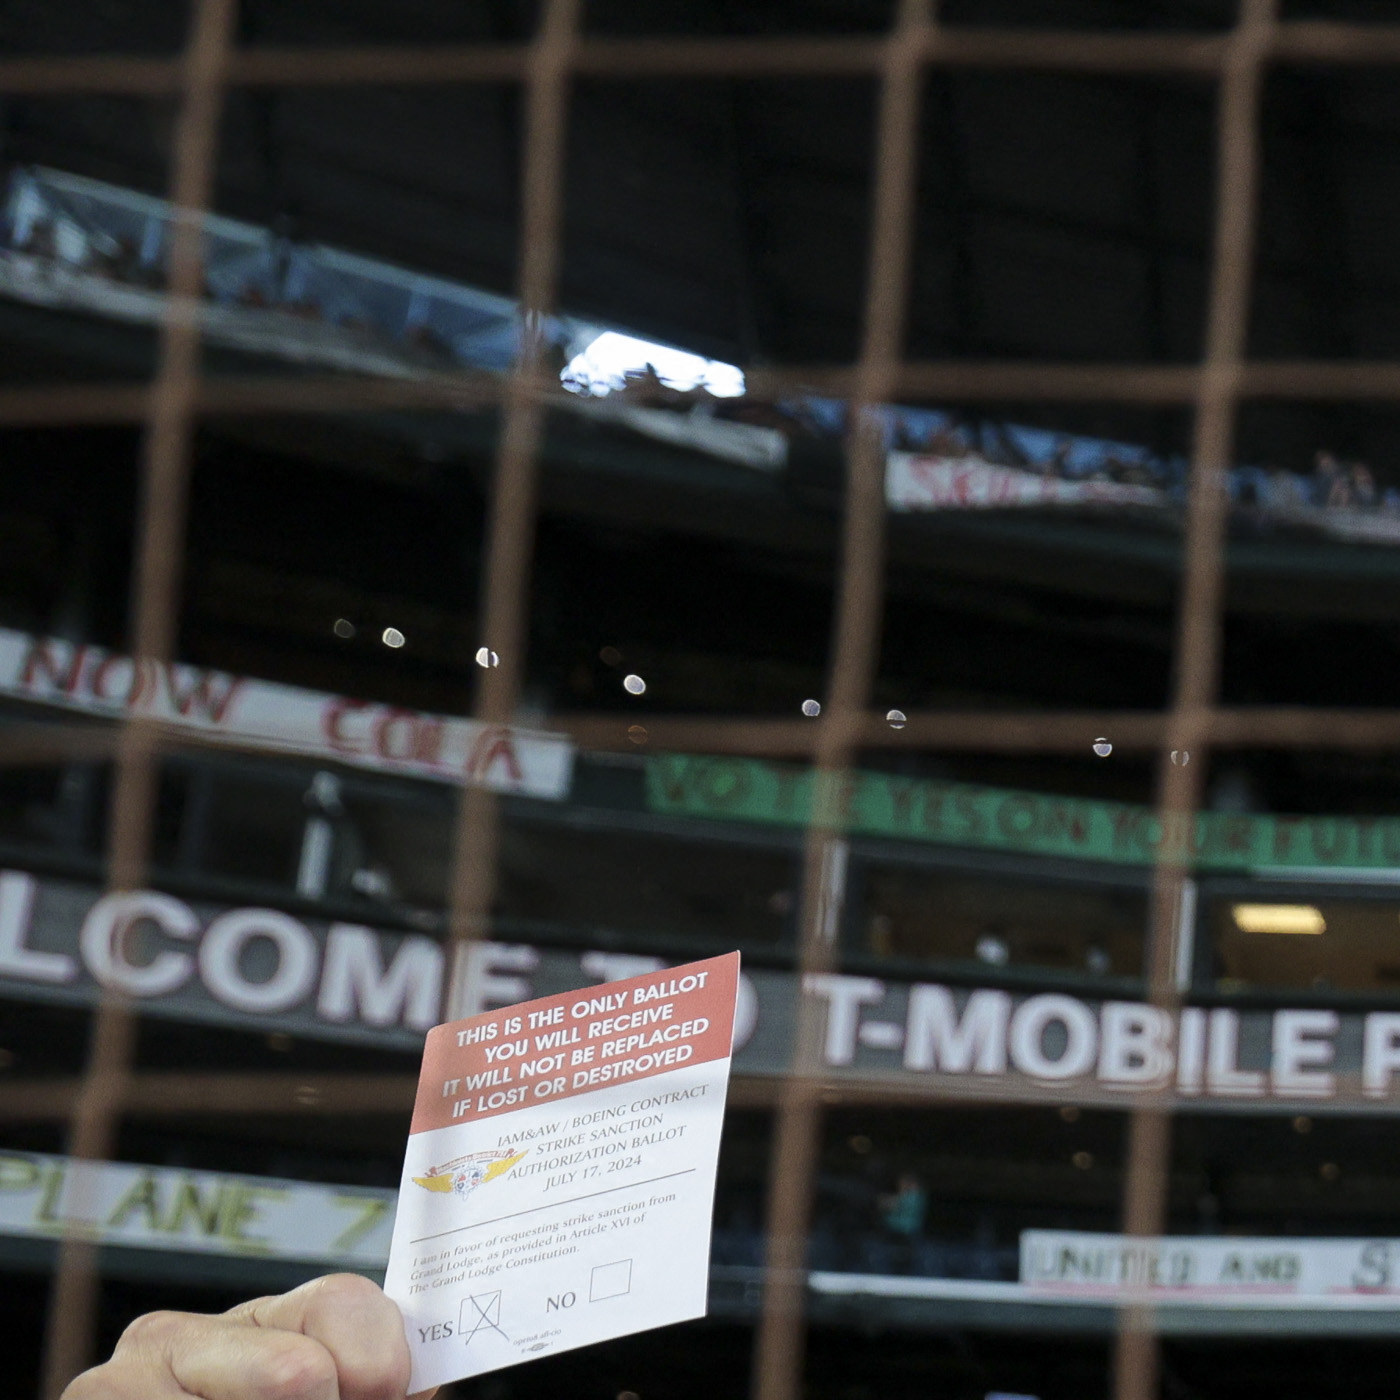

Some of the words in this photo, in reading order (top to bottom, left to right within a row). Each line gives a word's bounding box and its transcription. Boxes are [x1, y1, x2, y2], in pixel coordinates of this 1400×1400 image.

[20, 636, 245, 722] NOW
[457, 1021, 498, 1047] THIS
[504, 1016, 521, 1037] IS
[528, 1006, 564, 1031] THE
[571, 991, 628, 1020] ONLY
[633, 971, 709, 1003] BALLOT
[484, 1039, 528, 1064] YOU
[534, 1025, 581, 1052] WILL
[587, 1003, 674, 1038] RECEIVE
[806, 972, 1340, 1096] T-MOBILE
[442, 1077, 459, 1098] IT
[466, 1065, 512, 1094] WILL
[519, 1053, 566, 1078] NOT
[570, 1046, 594, 1066] BE
[601, 1017, 710, 1059] REPLACED
[452, 1097, 471, 1118] IF
[477, 1086, 526, 1113] LOST
[534, 1076, 566, 1098] OR
[572, 1044, 693, 1090] DESTROYED
[497, 1122, 561, 1148] IAM&AW
[572, 1104, 626, 1129] BOEING
[630, 1084, 709, 1113] CONTRACT
[536, 1133, 585, 1156] STRIKE
[590, 1113, 664, 1142] SANCTION
[507, 1139, 627, 1181] AUTHORIZATION
[631, 1124, 687, 1149] BALLOT
[542, 1170, 578, 1192] JULY
[582, 1165, 602, 1181] 17,
[607, 1154, 643, 1174] 2024
[410, 1265, 444, 1281] Grand
[486, 1251, 499, 1260] as
[501, 1236, 553, 1259] provided
[556, 1232, 567, 1243] in
[569, 1223, 608, 1240] Article
[610, 1216, 631, 1231] XVI
[633, 1211, 647, 1224] of
[440, 1250, 451, 1261] in
[454, 1242, 481, 1258] favor
[485, 1235, 499, 1247] of
[500, 1221, 560, 1244] requesting
[562, 1212, 595, 1229] strike
[598, 1201, 646, 1219] sanction
[648, 1193, 676, 1209] from
[408, 1282, 430, 1296] The
[432, 1272, 465, 1288] Grand
[468, 1263, 503, 1279] Lodge
[505, 1246, 580, 1269] Constitution.
[1219, 1249, 1298, 1284] AND
[418, 1321, 453, 1344] YES
[546, 1291, 576, 1313] NO
